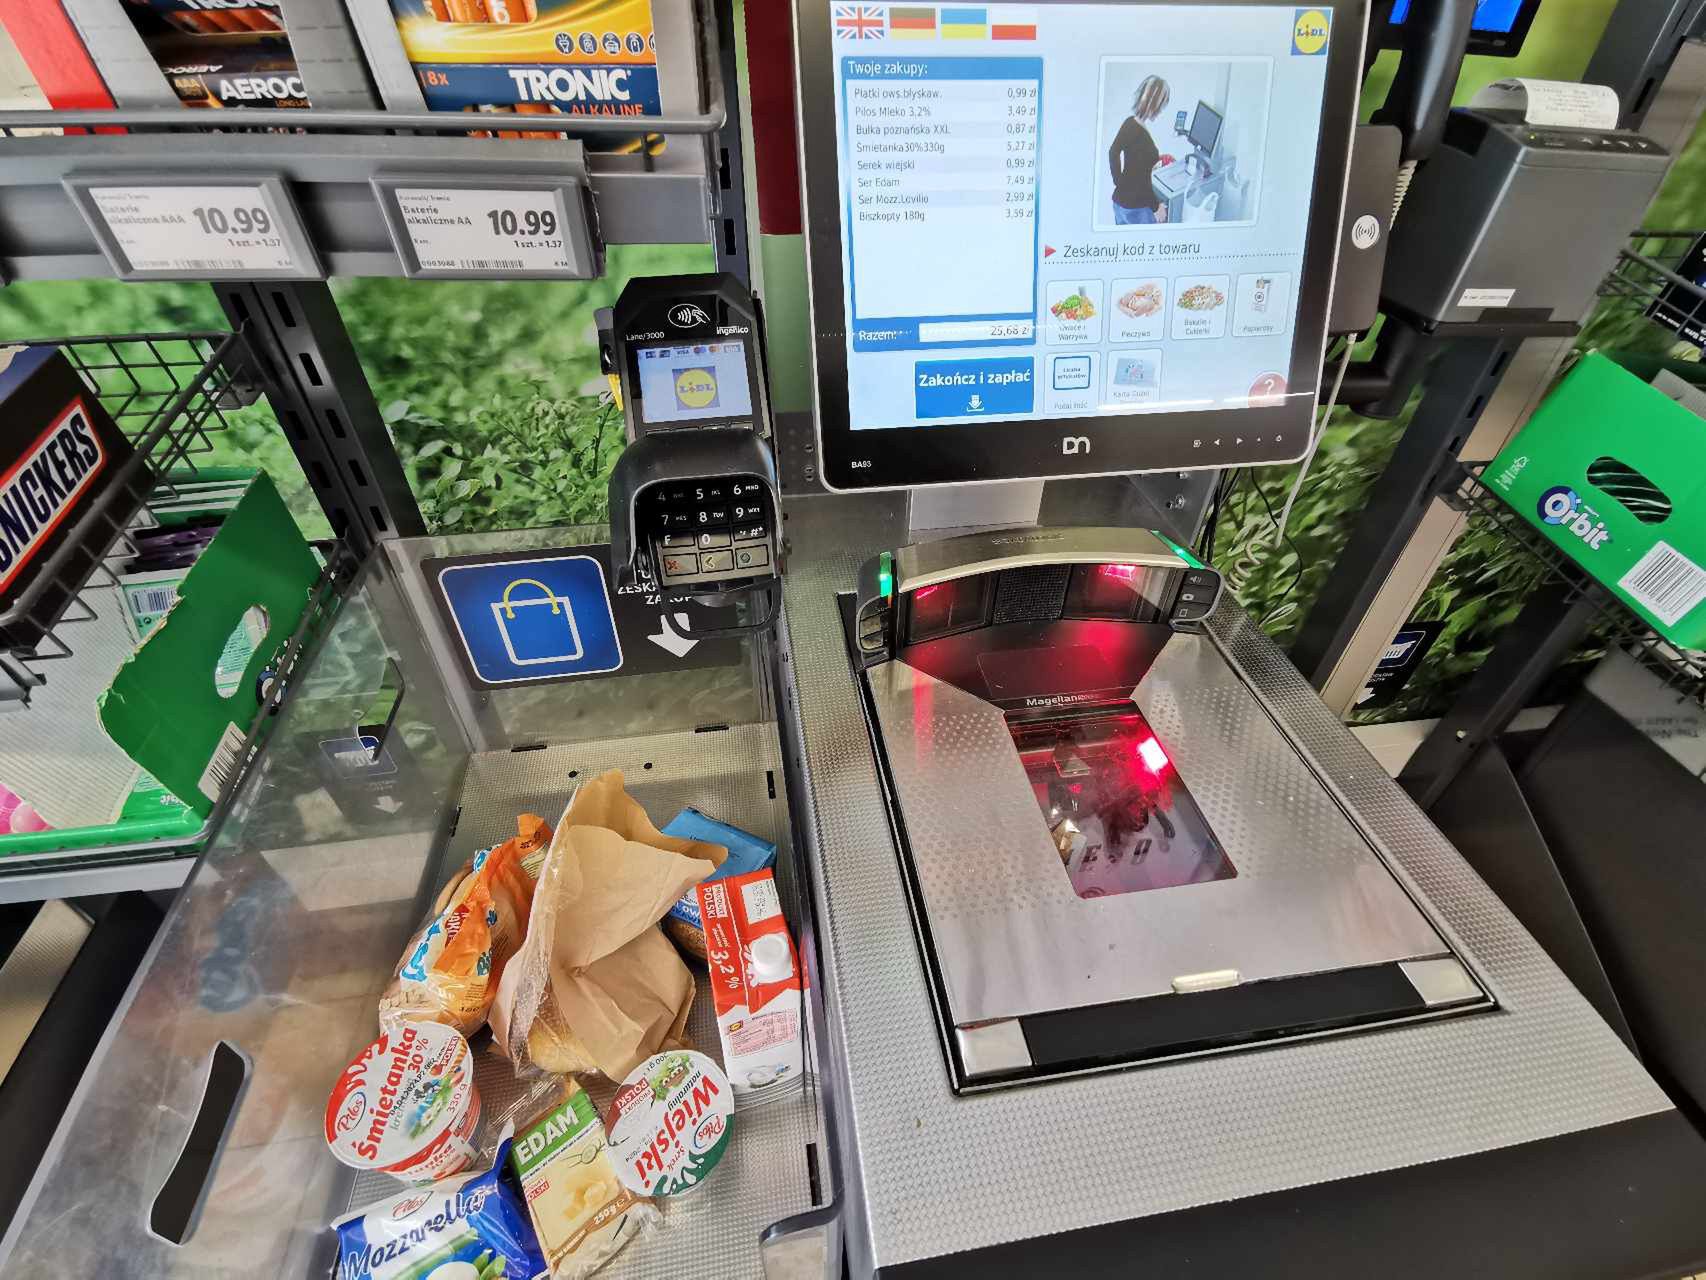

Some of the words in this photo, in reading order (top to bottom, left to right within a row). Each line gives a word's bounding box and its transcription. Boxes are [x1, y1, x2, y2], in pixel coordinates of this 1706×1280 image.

[848, 61, 882, 76] Twoje
[884, 61, 928, 76] zakupy:
[428, 72, 449, 86] 8x
[508, 69, 630, 101] TRONIC
[879, 106, 905, 116] Mleko
[857, 160, 882, 170] Serek
[886, 160, 915, 172] wiejski
[857, 178, 872, 187] Ser
[875, 178, 900, 187] Edam
[858, 195, 873, 205] Ser
[403, 205, 439, 215] Baterie
[193, 207, 271, 234] 10.99
[407, 216, 455, 225] alkaliczne
[457, 216, 473, 225] AA
[487, 209, 557, 236] 10.99
[859, 211, 900, 222] Biszkopty
[521, 240, 537, 248] szt.
[545, 240, 562, 248] 1.37
[1063, 244, 1119, 260] Zeskanuj
[1123, 243, 1144, 256] kod
[1148, 246, 1155, 255] z
[1158, 243, 1200, 254] towaru
[626, 331, 664, 341] Lane/3000
[716, 326, 749, 336] ingenico
[859, 330, 897, 341] Razem:
[919, 372, 975, 387] Zakończ
[987, 369, 1030, 386] zapłać
[696, 488, 704, 500] 5
[733, 484, 742, 495] 6
[699, 511, 708, 523] 8
[735, 507, 744, 518] 9
[661, 514, 669, 525] 7
[1545, 493, 1608, 550] Orbit
[664, 534, 671, 545] F
[1026, 695, 1078, 706] Magellan
[703, 887, 716, 919] POLSKI
[440, 1035, 460, 1066] POLSKI
[351, 1027, 418, 1160] Śmietanka
[617, 1077, 649, 1107] POLSKI
[667, 1070, 701, 1111] naturalny
[337, 1099, 363, 1132] Pilos
[515, 1105, 580, 1165] EDAM
[635, 1075, 720, 1189] Wiejski
